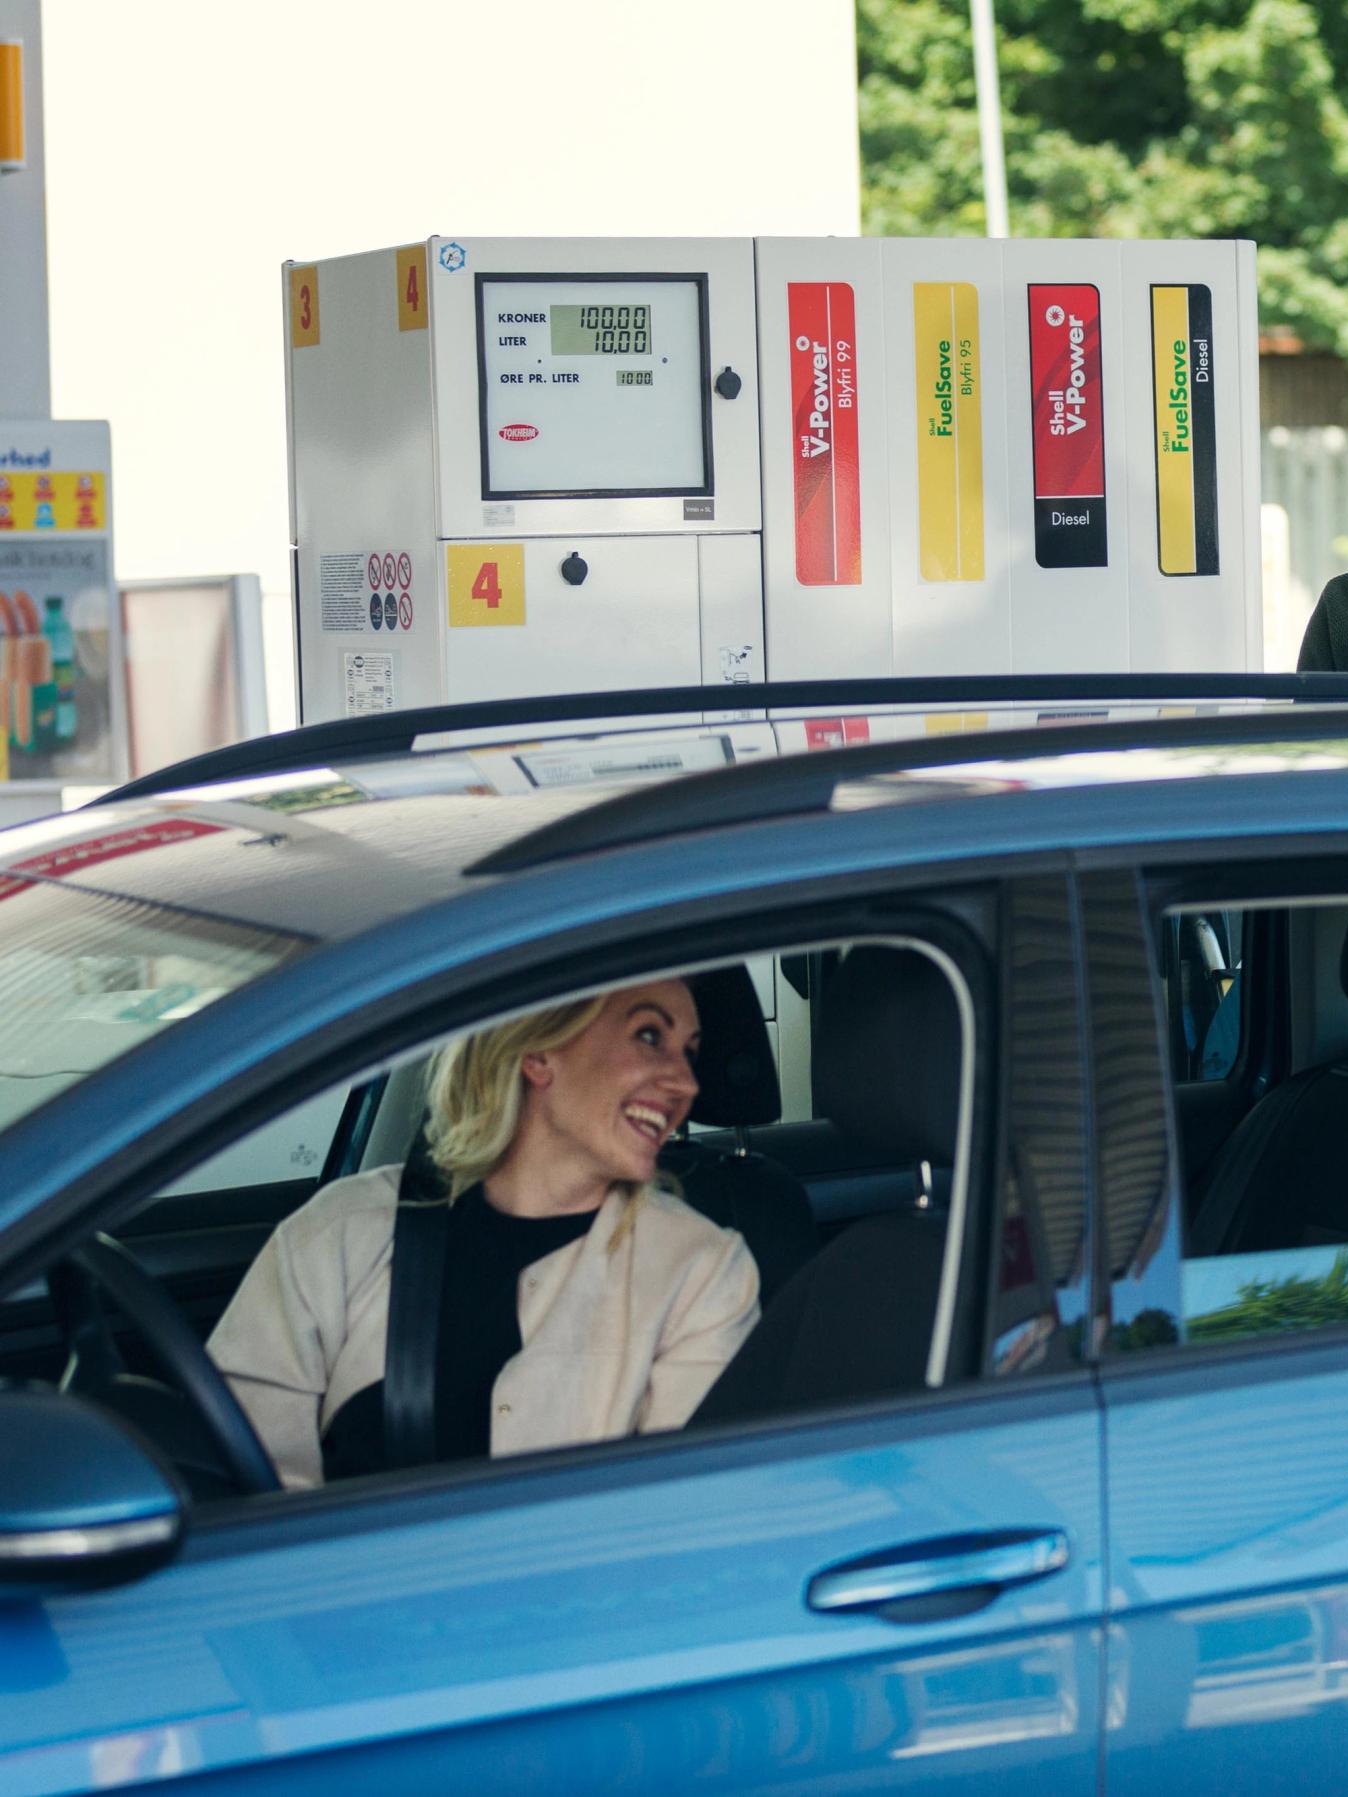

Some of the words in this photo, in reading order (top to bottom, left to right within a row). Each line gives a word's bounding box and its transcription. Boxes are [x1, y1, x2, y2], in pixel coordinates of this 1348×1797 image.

[406, 265, 419, 312] 4
[300, 285, 311, 330] 3
[498, 313, 547, 323] KRONER
[581, 306, 646, 331] 100,00
[499, 336, 527, 346] LITER
[595, 331, 647, 354] 10,00
[836, 340, 851, 362] 99
[959, 339, 972, 358] 95
[500, 373, 524, 384] ØRE
[528, 373, 547, 384] PR.
[552, 373, 580, 383] LITER
[960, 362, 975, 396] Blyfri
[1066, 314, 1087, 436] V-Power
[1193, 338, 1209, 383] Diesel
[809, 341, 830, 458] V-Power
[837, 368, 855, 408] Blyfri
[935, 340, 953, 437] FuelSave
[1168, 339, 1189, 453] FuelSave
[1048, 390, 1066, 436] Shell
[801, 435, 810, 458] Shell
[1052, 510, 1090, 526] Diesel
[471, 562, 503, 608] 4
